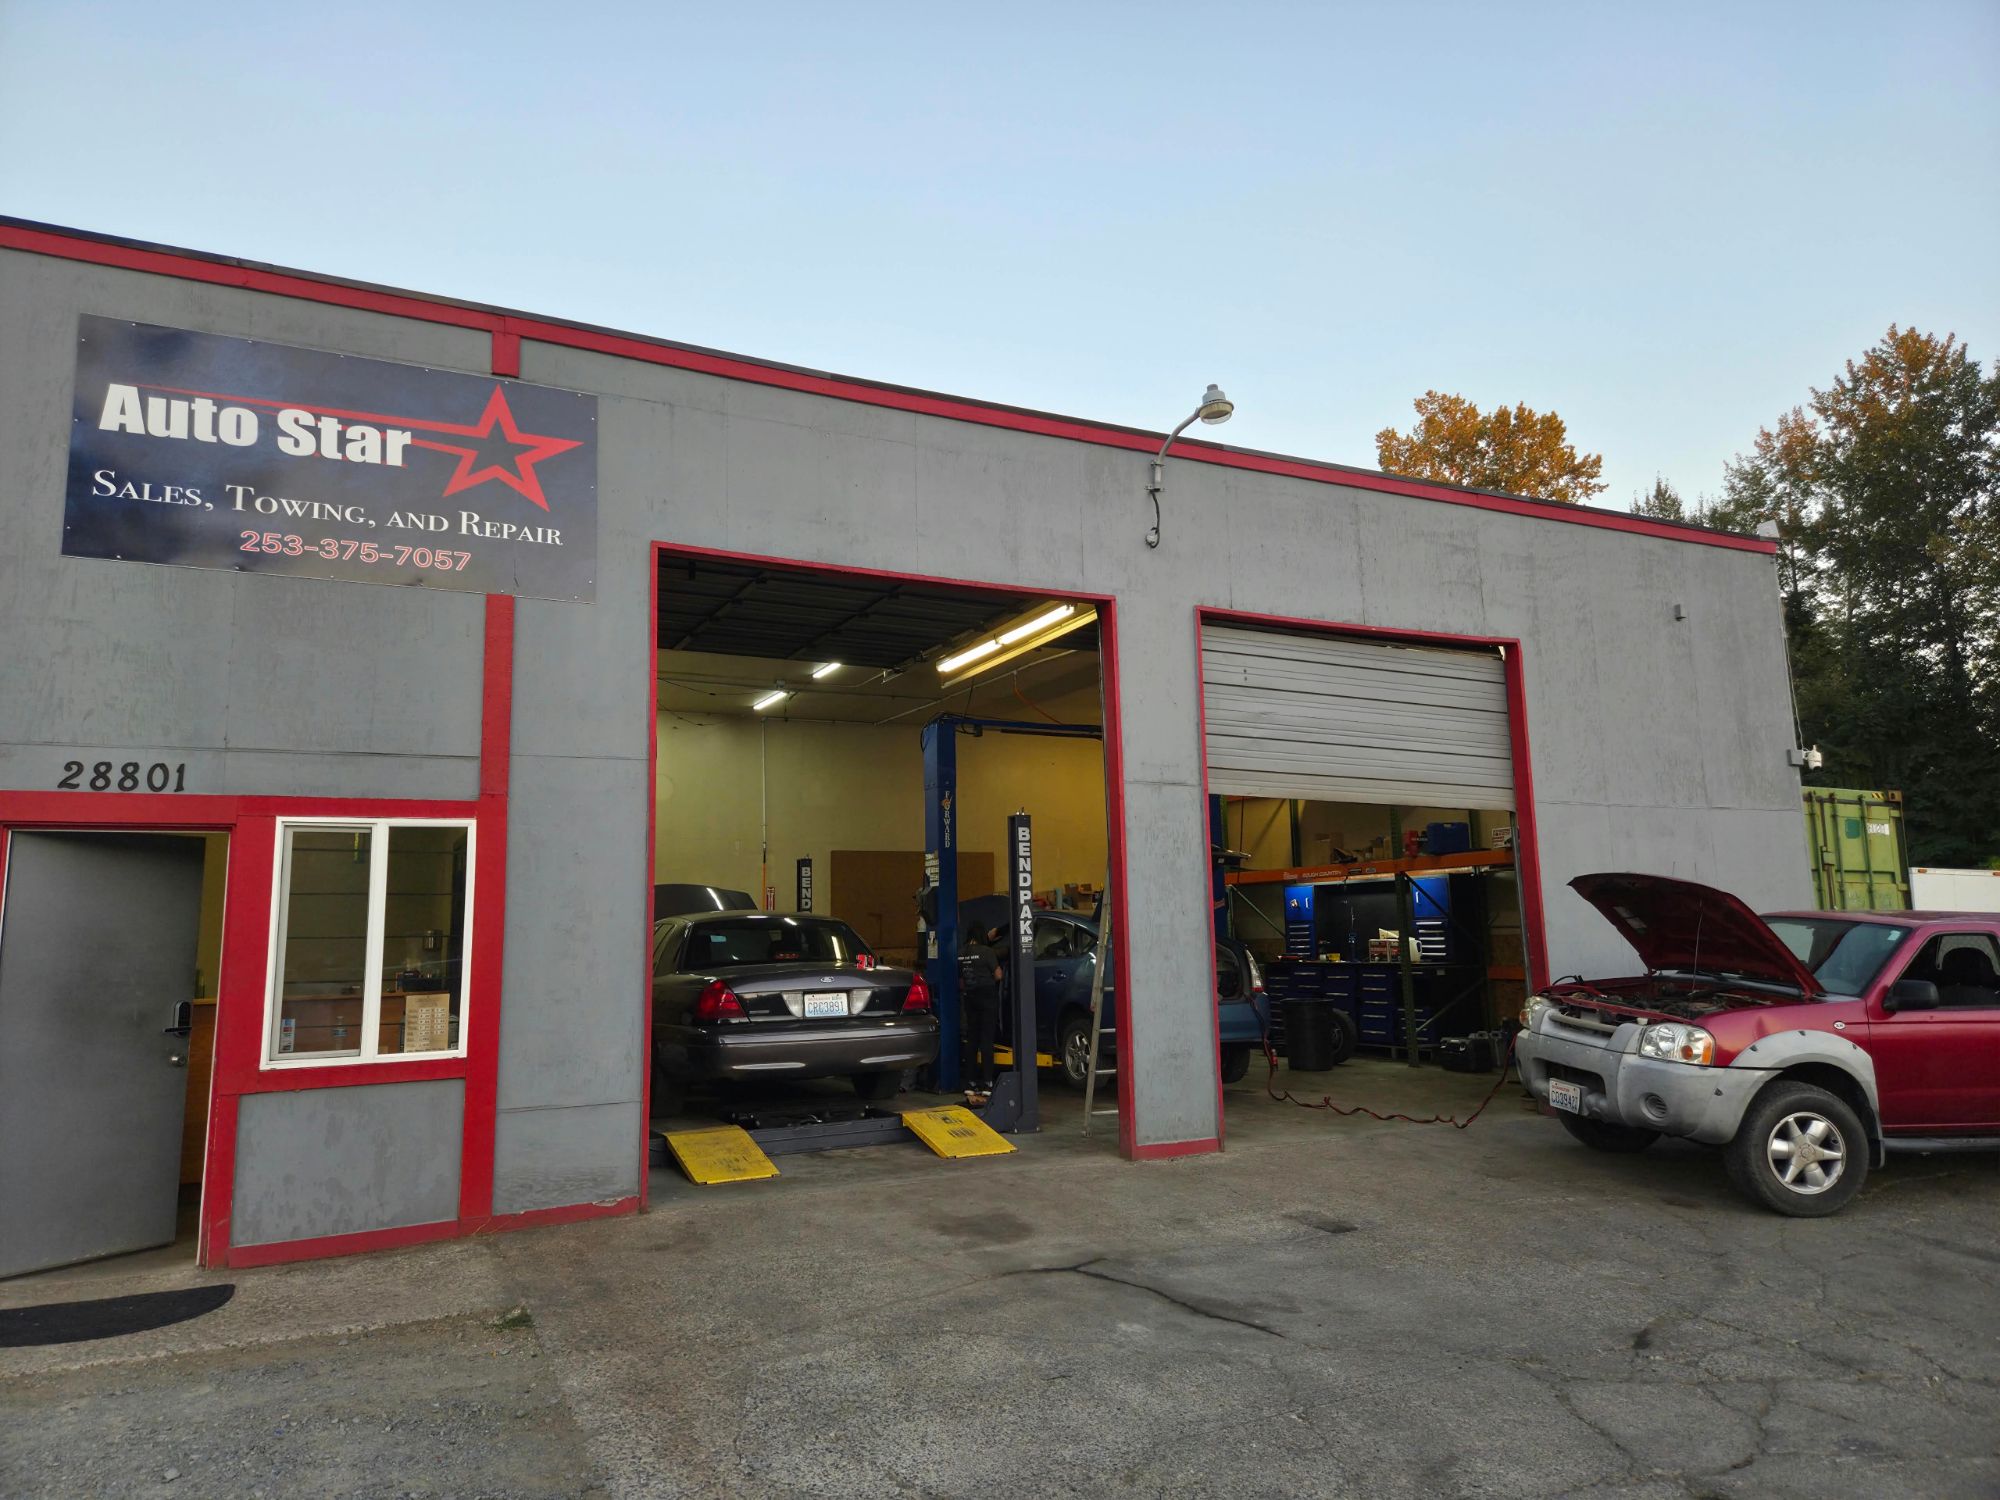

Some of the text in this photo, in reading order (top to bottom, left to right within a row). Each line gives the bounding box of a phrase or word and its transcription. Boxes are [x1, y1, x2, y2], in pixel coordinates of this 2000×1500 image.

[99, 383, 412, 467] Auto Star
[92, 469, 564, 546] SALES, TOWING, AND REPAIR
[240, 530, 471, 572] 253-375-7057
[57, 760, 185, 792] 28801
[801, 866, 811, 910] BEND
